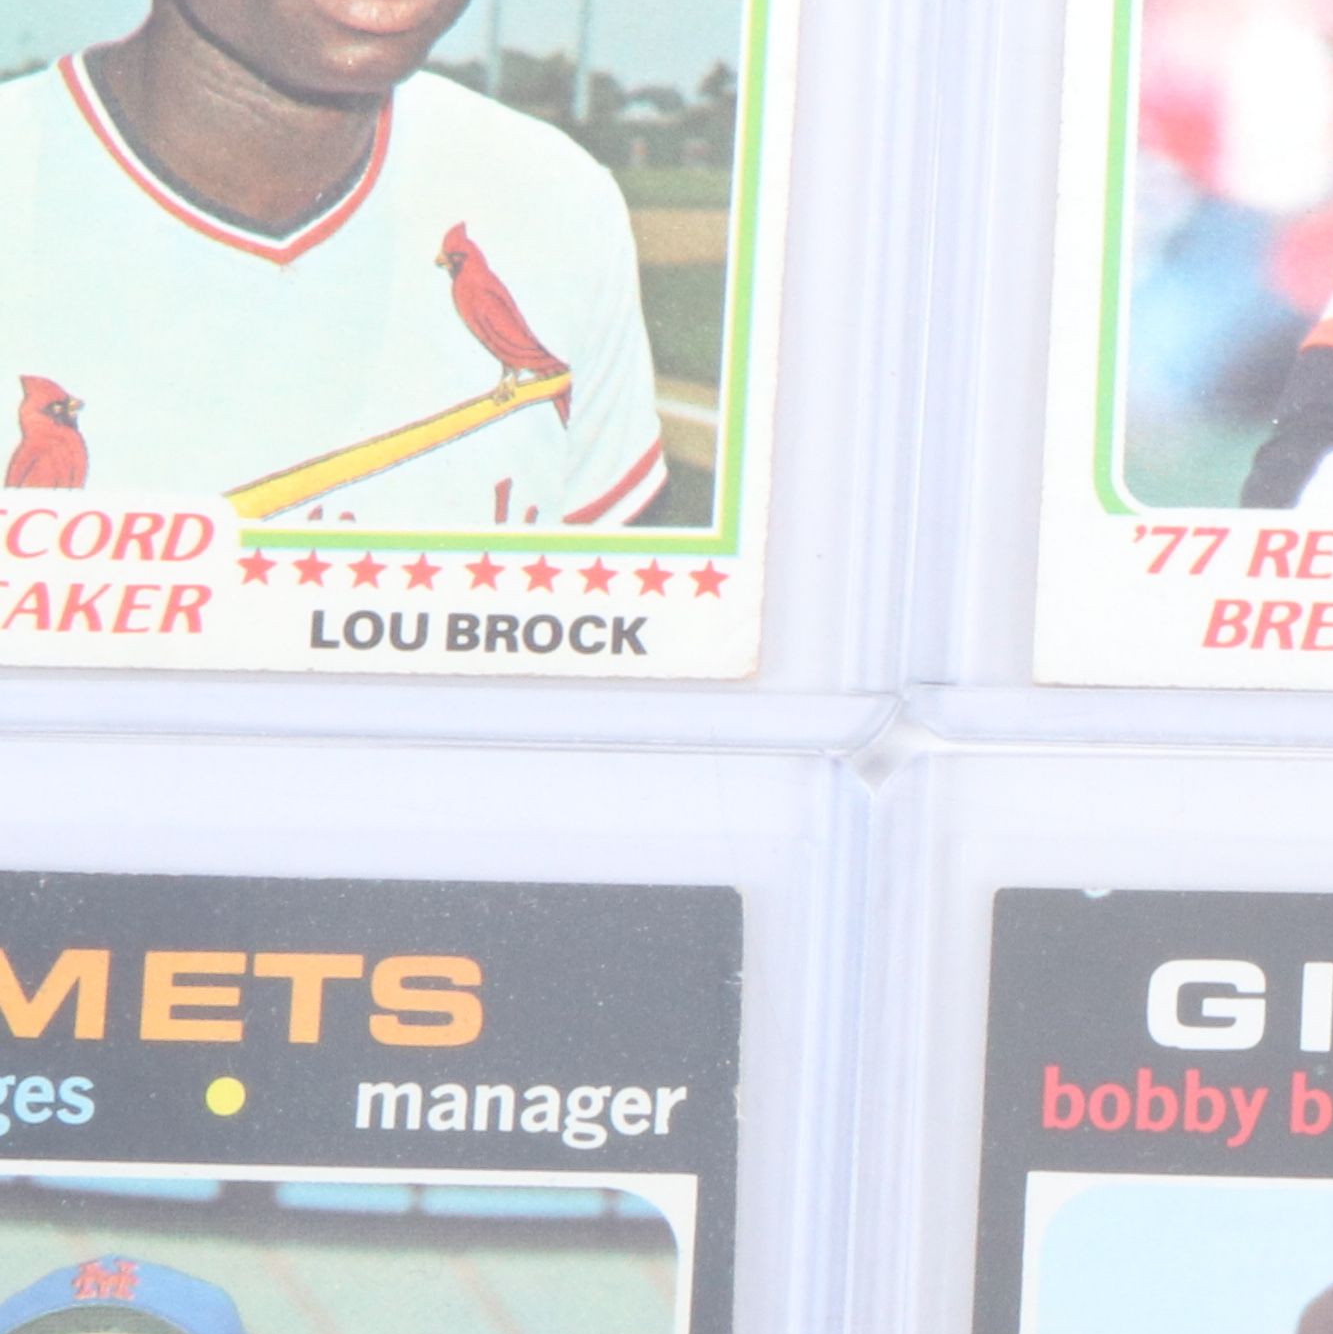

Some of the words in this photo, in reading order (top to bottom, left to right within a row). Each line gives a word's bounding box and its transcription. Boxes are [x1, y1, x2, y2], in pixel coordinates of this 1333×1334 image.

[0, 509, 214, 562] CORD
[1134, 524, 1230, 575] '77
[0, 581, 212, 634] AKER
[310, 610, 429, 651] LOU
[446, 613, 647, 655] BROCK
[0, 948, 483, 1047] METS
[356, 1082, 687, 1149] manager
[1043, 1065, 1268, 1147] bobby
